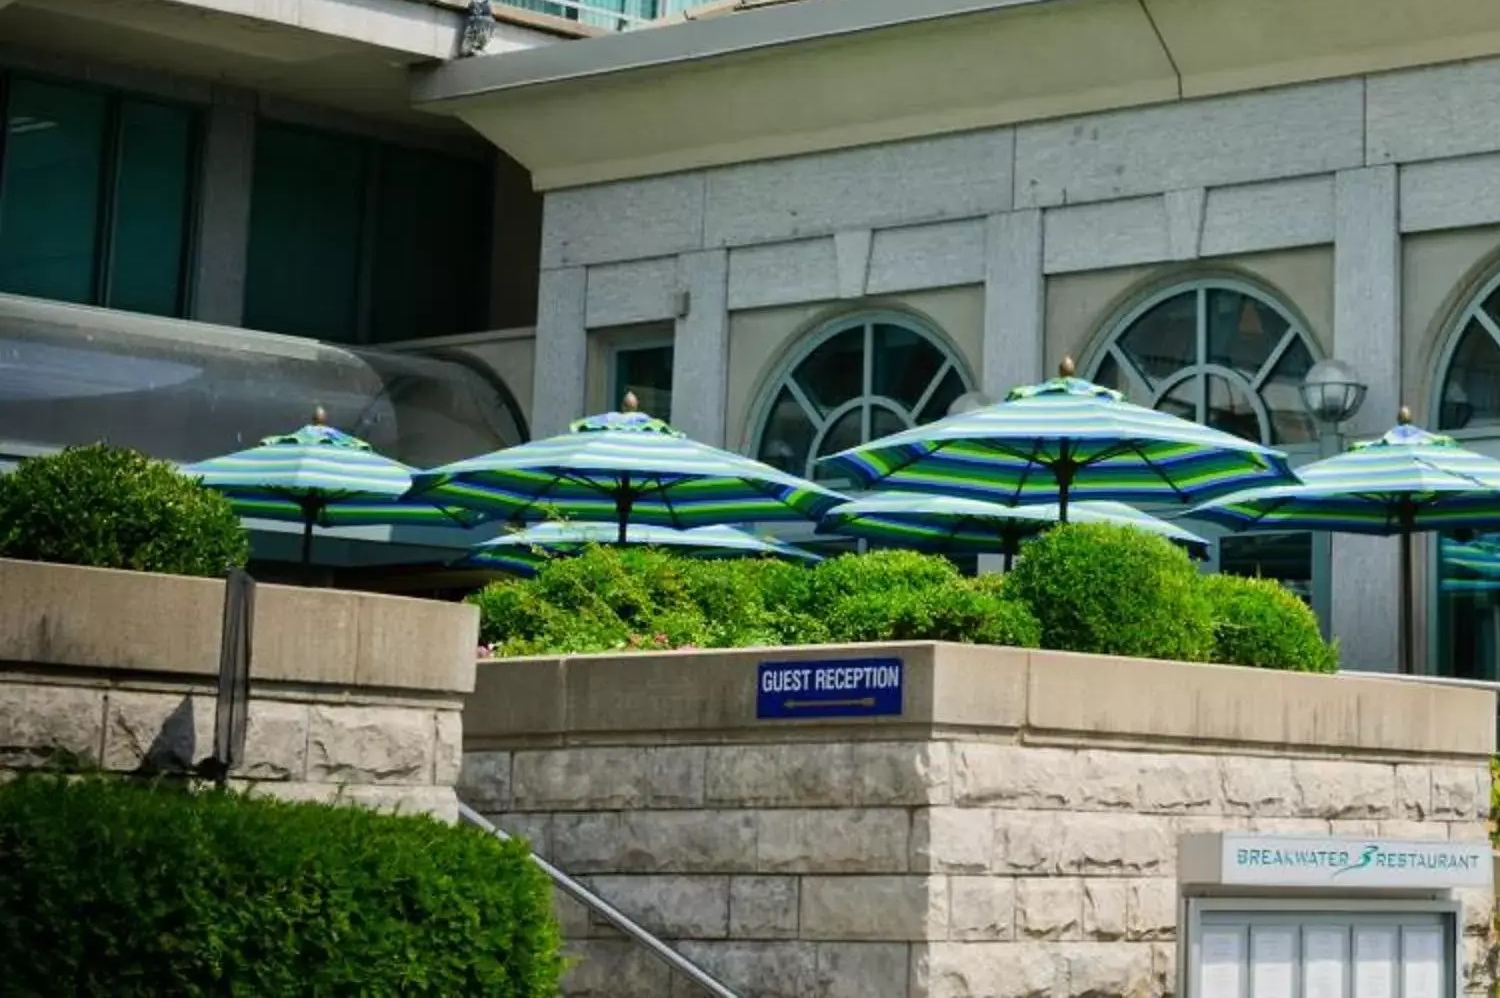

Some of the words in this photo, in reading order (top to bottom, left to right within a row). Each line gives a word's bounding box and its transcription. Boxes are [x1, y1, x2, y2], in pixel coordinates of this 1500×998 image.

[762, 670, 811, 692] GUEST
[815, 666, 899, 690] RECEPTION
[1237, 849, 1349, 867] BREAKWATER
[1376, 852, 1480, 869] RESTAURANT
